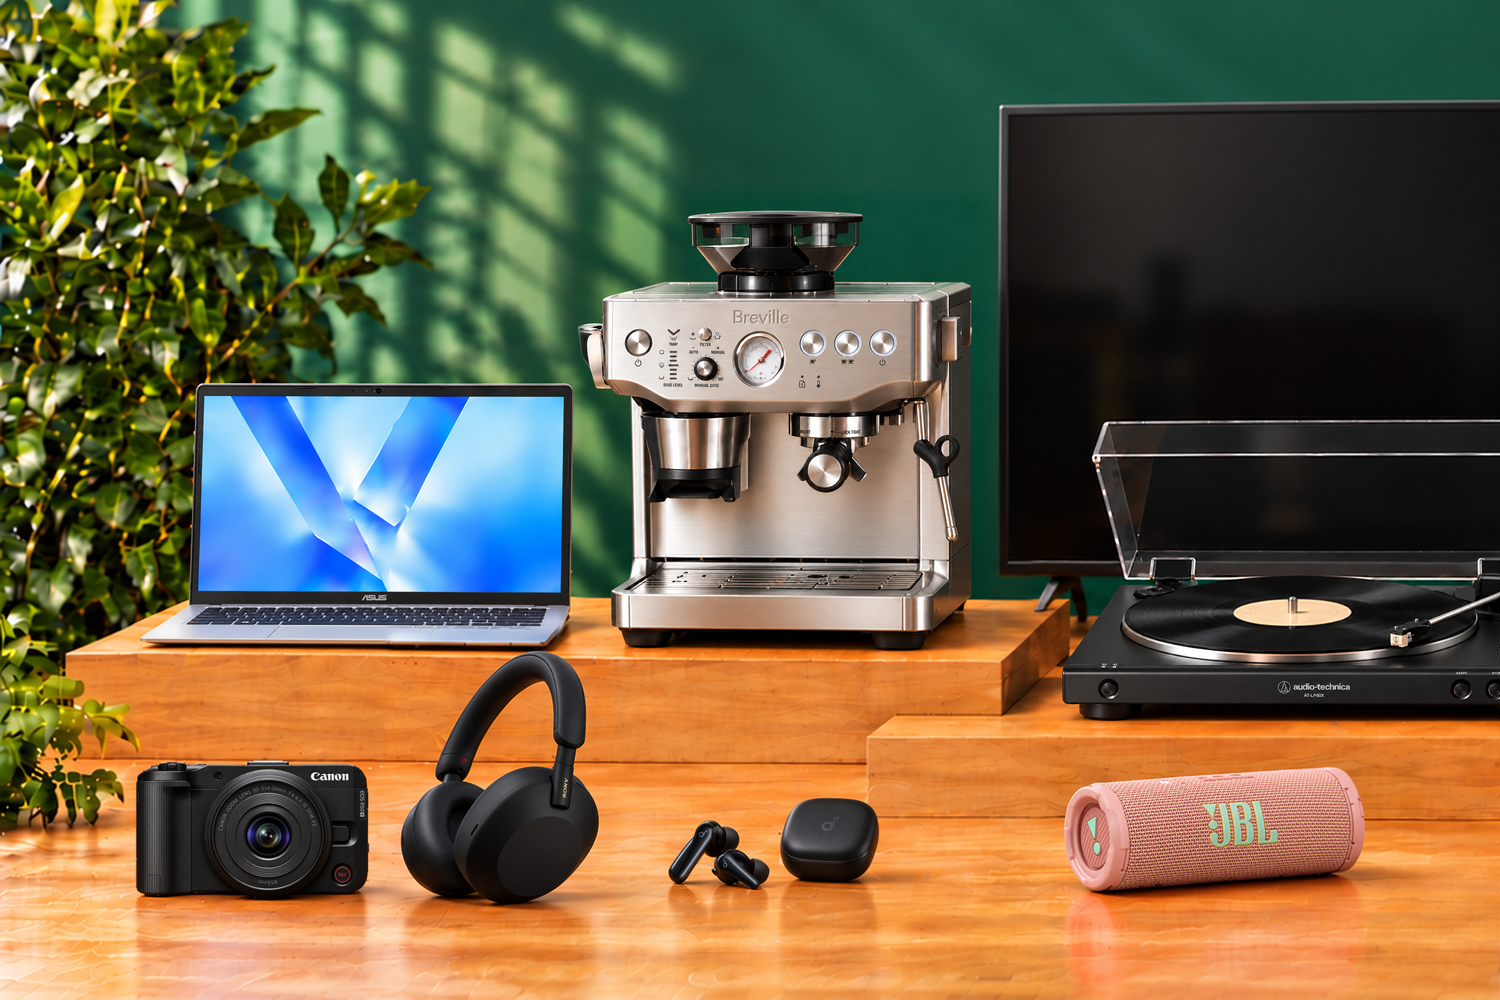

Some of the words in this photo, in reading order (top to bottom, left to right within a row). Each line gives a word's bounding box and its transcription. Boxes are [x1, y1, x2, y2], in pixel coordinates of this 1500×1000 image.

[732, 309, 790, 324] Breville
[1293, 682, 1351, 691] audio-technica
[310, 771, 349, 781] Canon
[218, 812, 228, 832] CANON
[225, 797, 239, 813] ZOOM
[238, 789, 252, 800] LENS
[1202, 800, 1278, 848] JBL
